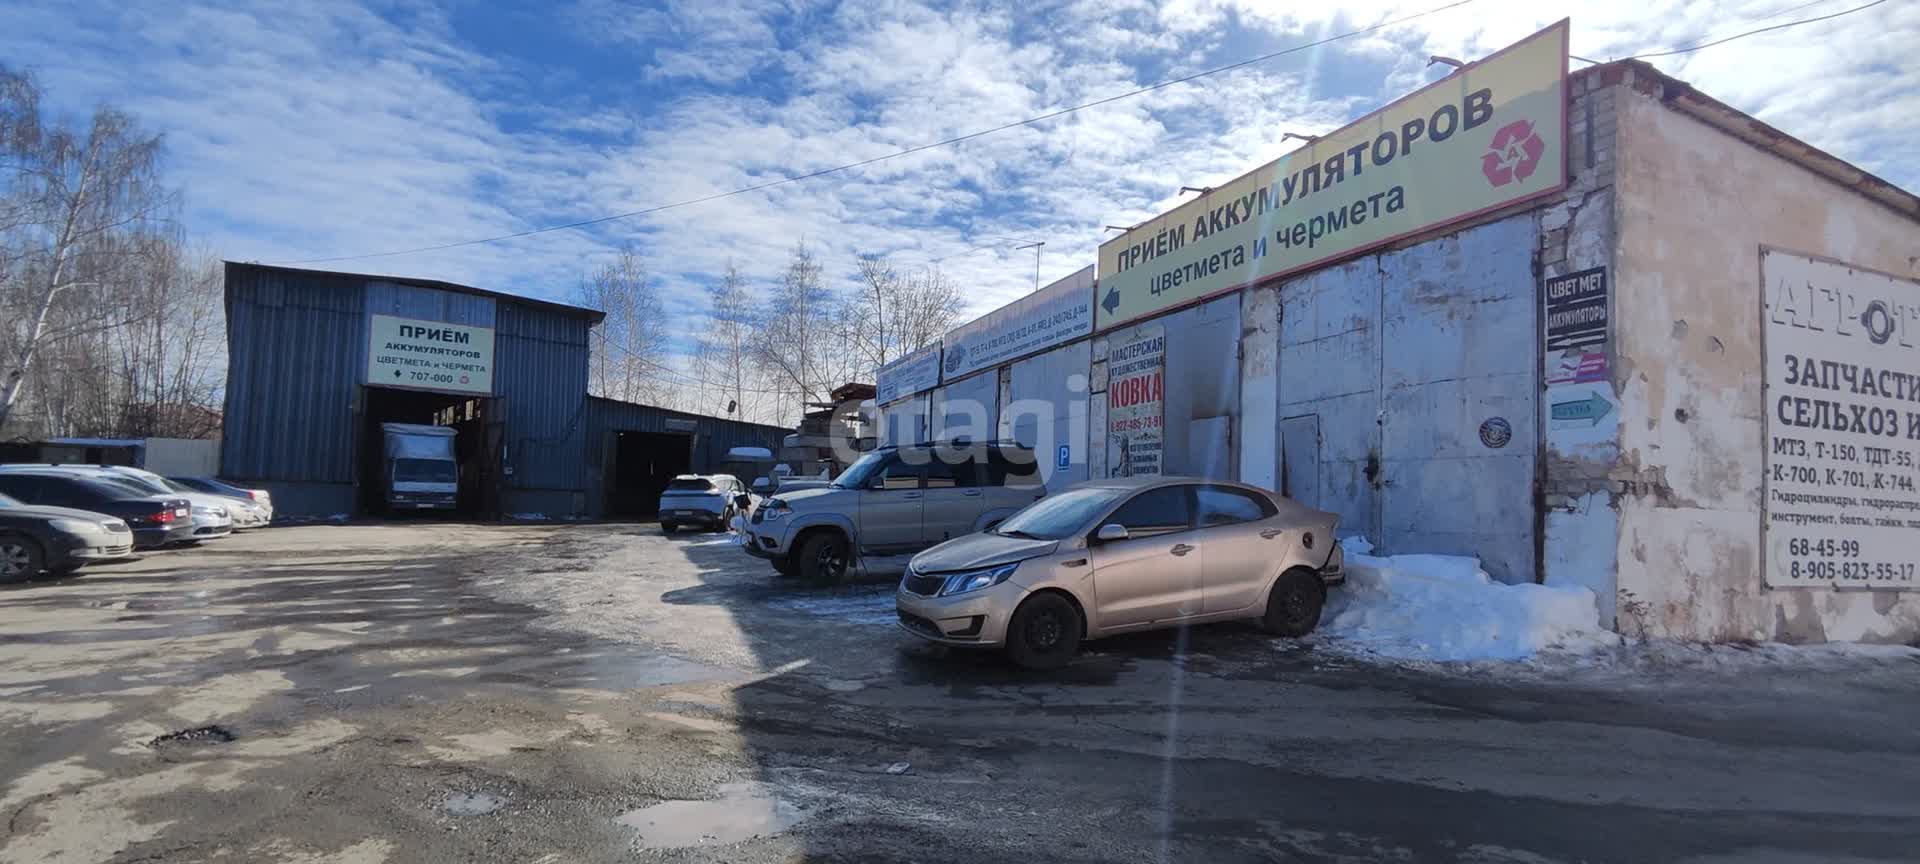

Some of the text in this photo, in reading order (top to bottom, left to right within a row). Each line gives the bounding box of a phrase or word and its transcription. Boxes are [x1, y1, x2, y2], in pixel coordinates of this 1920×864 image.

[1118, 88, 1494, 273] ПРИЁМ АККУМУЛЯТОРОВ
[1150, 185, 1405, 297] цветмета и чермета
[1550, 273, 1604, 298] ЦВЕТ МЕТ
[1550, 303, 1606, 329] АККУМУЛЯТОРЫ
[399, 324, 470, 345] ПРИЁМ
[384, 342, 481, 359] АККУМУЛЯТОРОВ
[1111, 336, 1163, 363] МАСТЕРСКАЯ
[376, 355, 431, 368] ЦВЕТМЕТА
[441, 362, 487, 373] ЧЕРМЕТА
[410, 371, 454, 384] 707-000
[1784, 354, 1920, 402] ЗАПЧАСТИ
[1111, 373, 1162, 409] КОВКА
[1777, 395, 1899, 437] СЕЛЬХОЗ
[1773, 437, 1915, 469] МТЗ, Т-150, ТДТ-55,
[1772, 463, 1916, 494] К-700, К-701, К-744,
[1789, 537, 1860, 558] 68-45-99
[1790, 560, 1915, 581] 8-905-823-55-17
